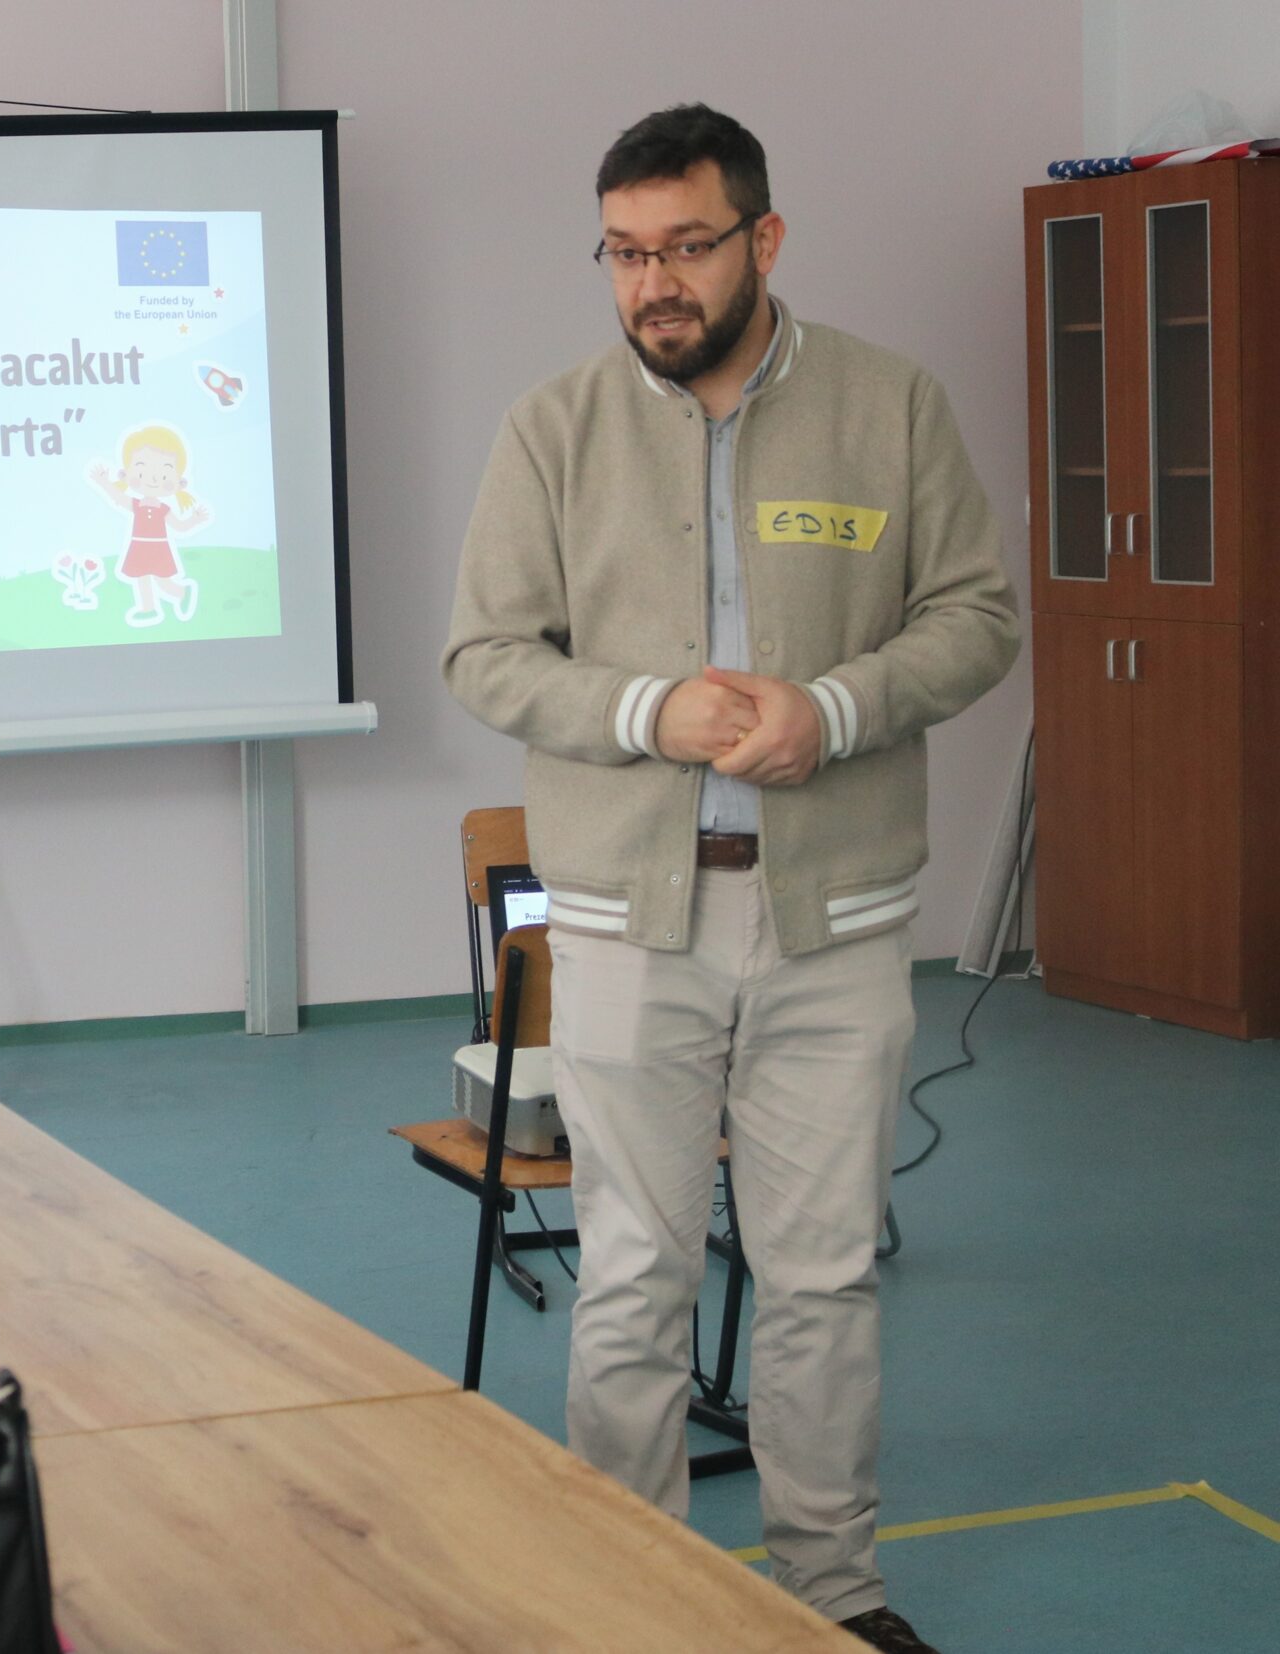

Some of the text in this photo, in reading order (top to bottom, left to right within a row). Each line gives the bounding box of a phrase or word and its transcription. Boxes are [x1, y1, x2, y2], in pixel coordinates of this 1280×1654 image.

[139, 296, 194, 307] Funded by
[114, 309, 217, 321] the European Union
[772, 511, 857, 541] EDIS
